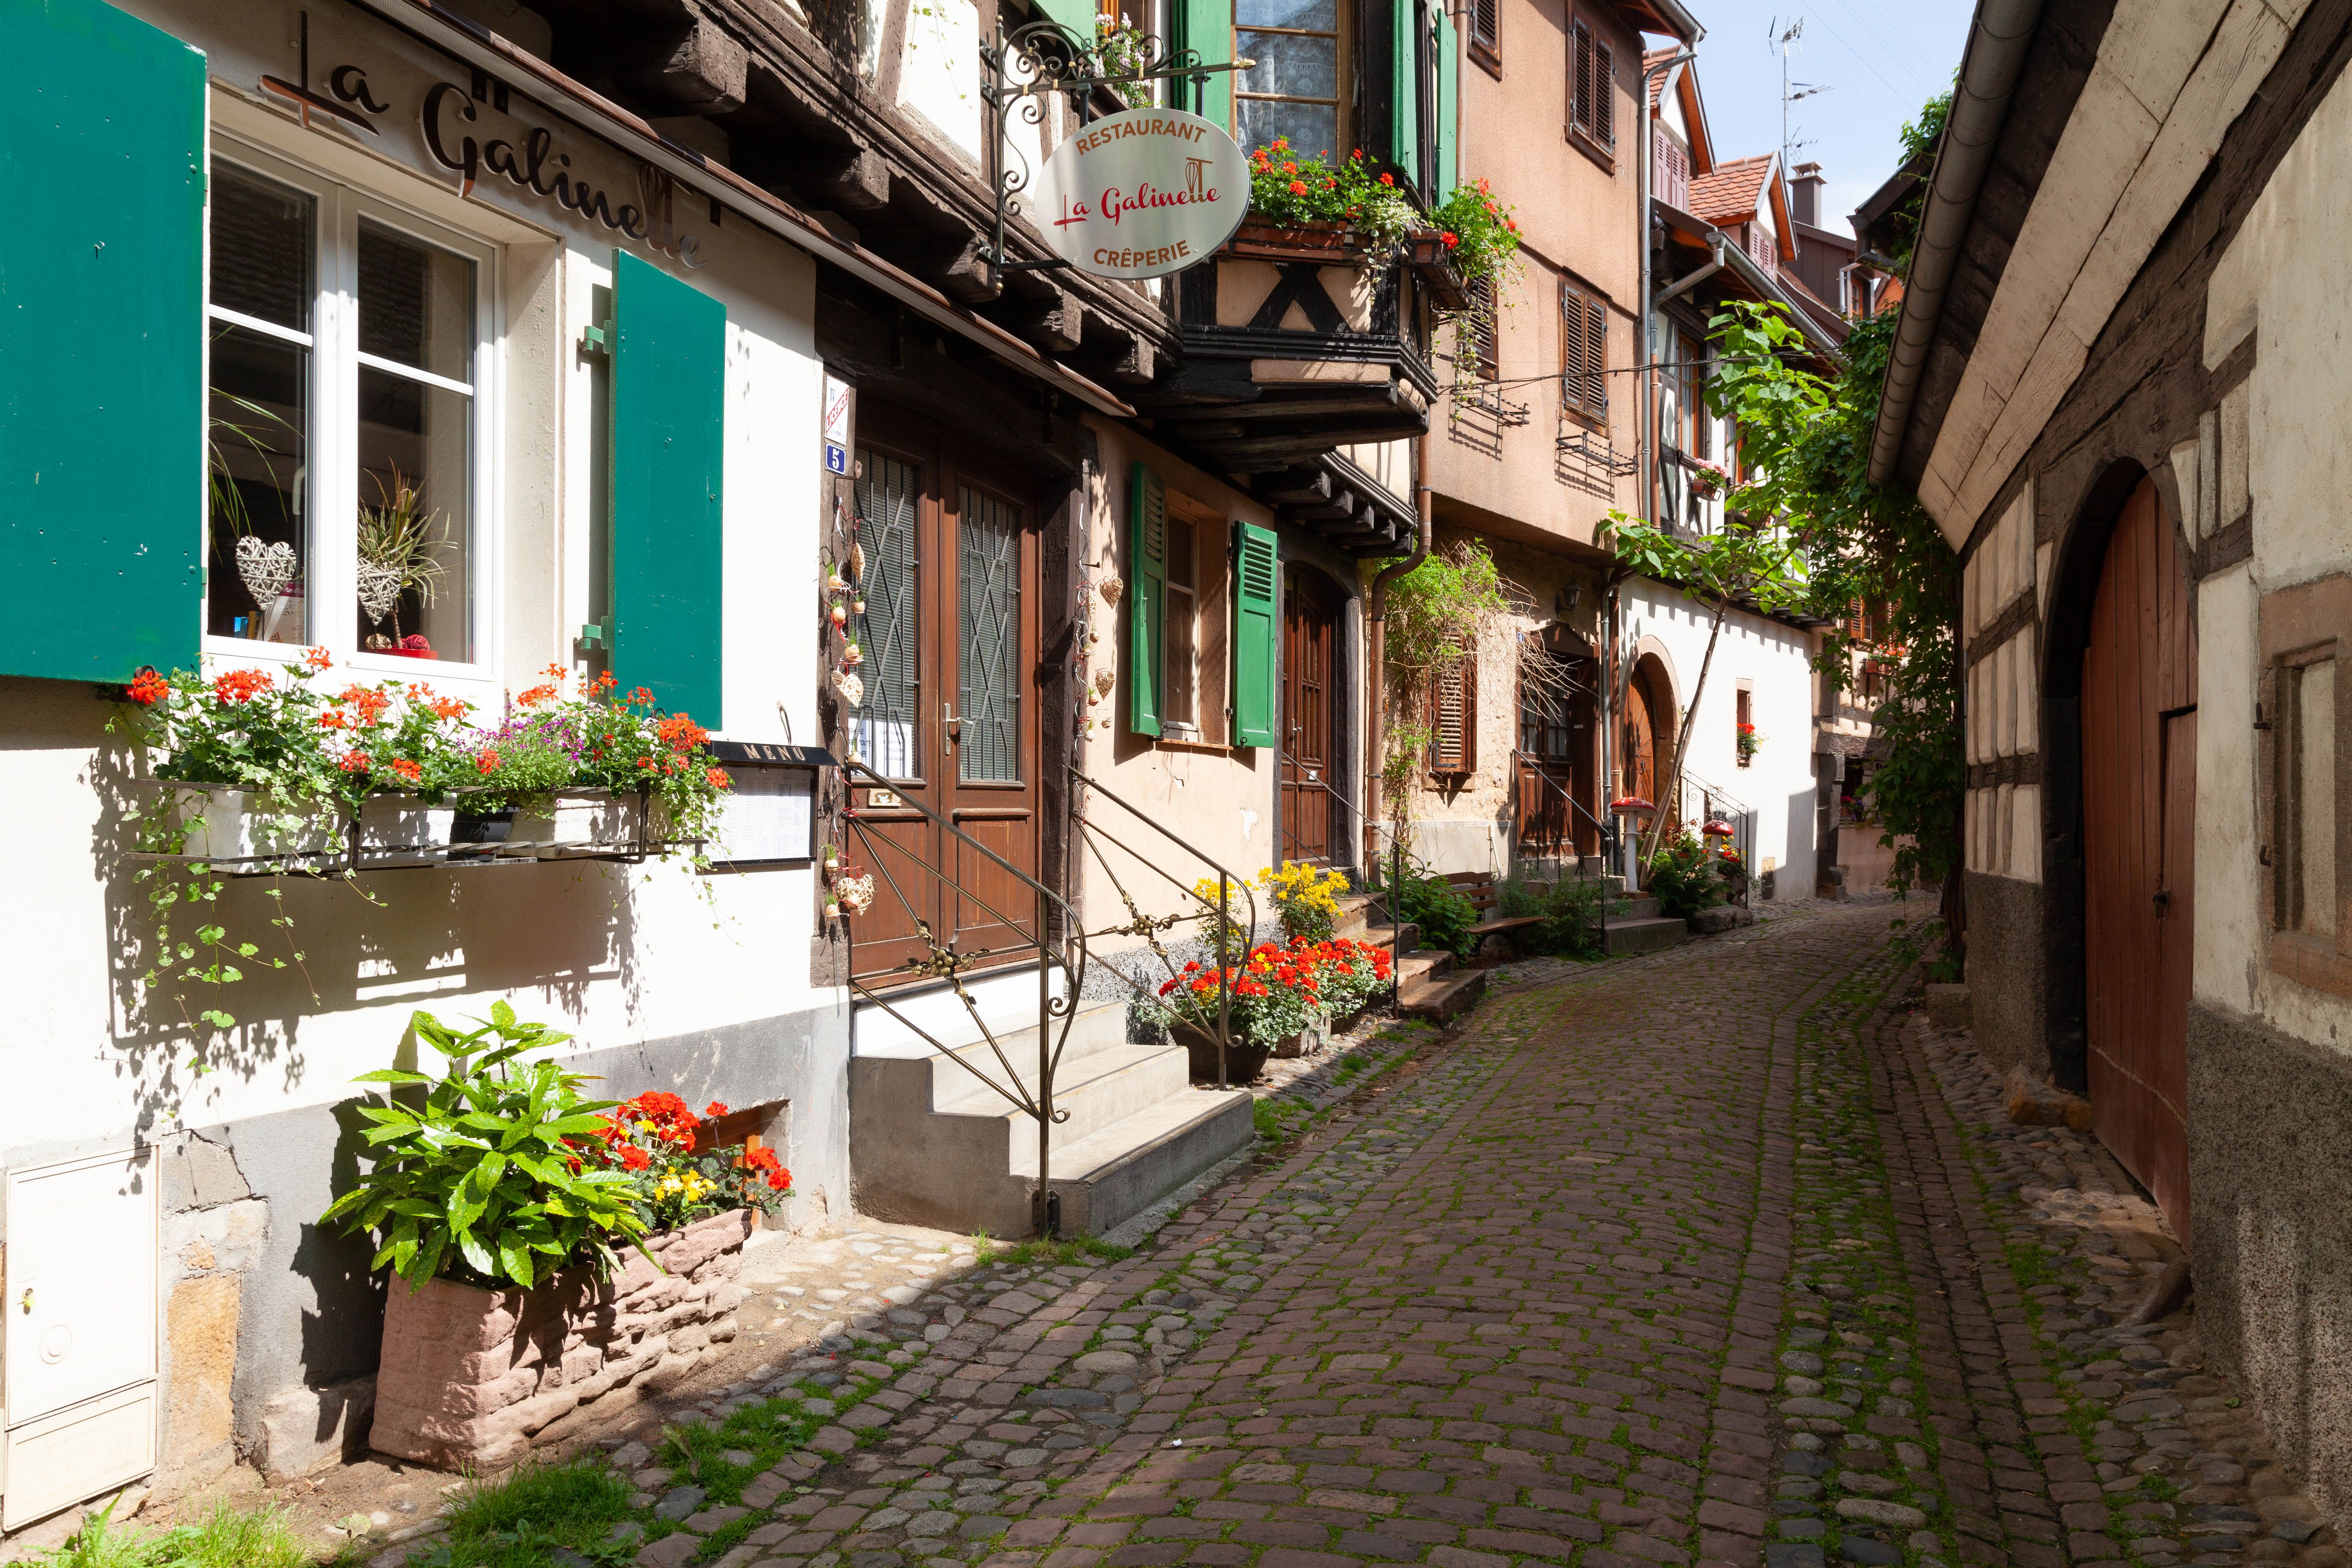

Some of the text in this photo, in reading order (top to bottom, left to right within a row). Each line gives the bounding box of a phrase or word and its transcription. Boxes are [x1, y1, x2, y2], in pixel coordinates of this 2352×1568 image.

[258, 10, 709, 268] La Galinette
[1075, 119, 1207, 156] RESTAURANT
[1053, 157, 1221, 232] La Galinette
[1093, 240, 1190, 268] CRÊPERIE
[826, 389, 847, 430] LICENCE
[832, 448, 840, 469] 5
[742, 744, 806, 761] MENU
